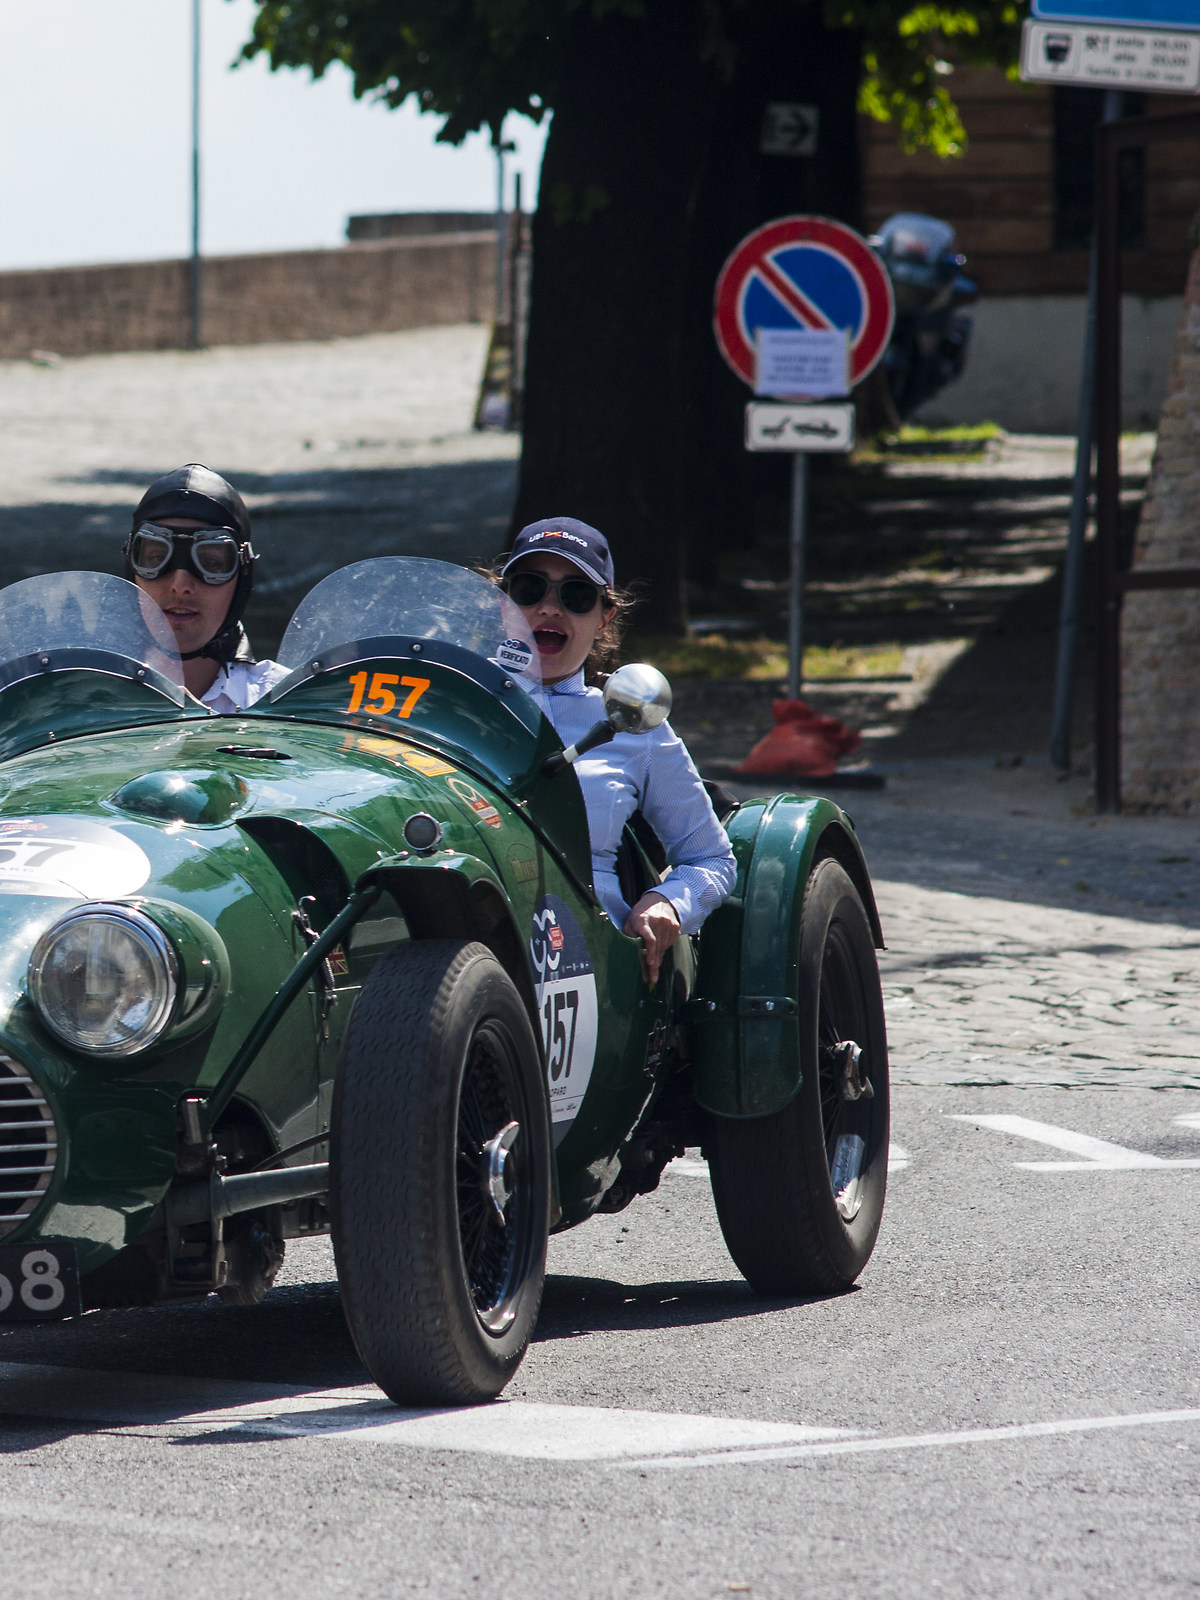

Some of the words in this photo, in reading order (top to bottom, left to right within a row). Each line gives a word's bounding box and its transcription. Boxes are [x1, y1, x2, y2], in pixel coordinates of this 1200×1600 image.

[562, 531, 588, 548] Banca
[500, 649, 529, 665] VERIFICATO
[347, 671, 431, 719] 157
[544, 990, 579, 1082] 157
